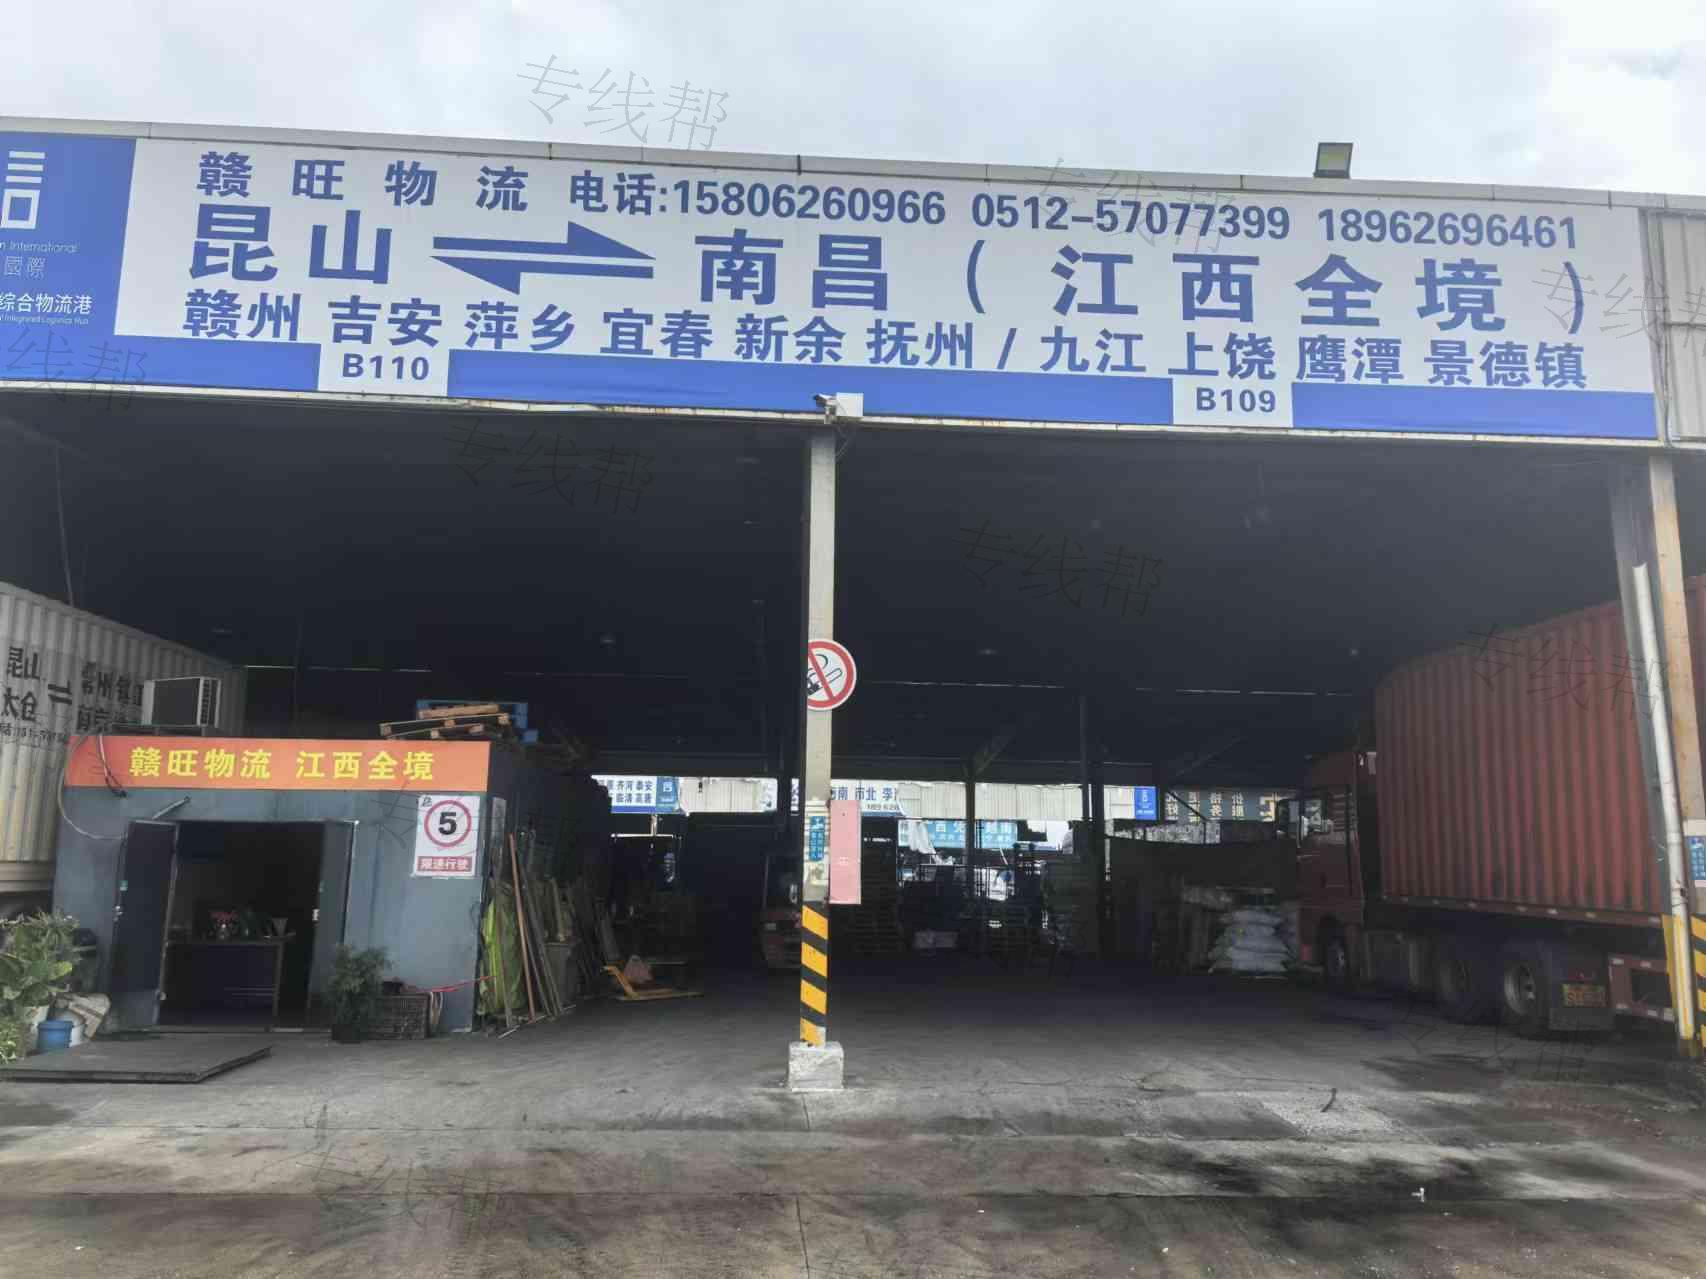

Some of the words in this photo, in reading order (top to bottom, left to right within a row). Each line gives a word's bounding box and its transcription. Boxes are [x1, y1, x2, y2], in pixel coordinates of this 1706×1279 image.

[197, 152, 529, 211] 赣旺物流
[972, 193, 1290, 240] 0512-57077399
[1318, 208, 1576, 249] 18962696461
[190, 203, 393, 285] 昆山
[342, 352, 430, 381] B110
[1424, 340, 1587, 388] 景德镇
[1196, 387, 1276, 413] B109
[129, 747, 273, 778] 赣旺物流
[296, 751, 436, 782] 江西全境
[438, 811, 457, 835] 5
